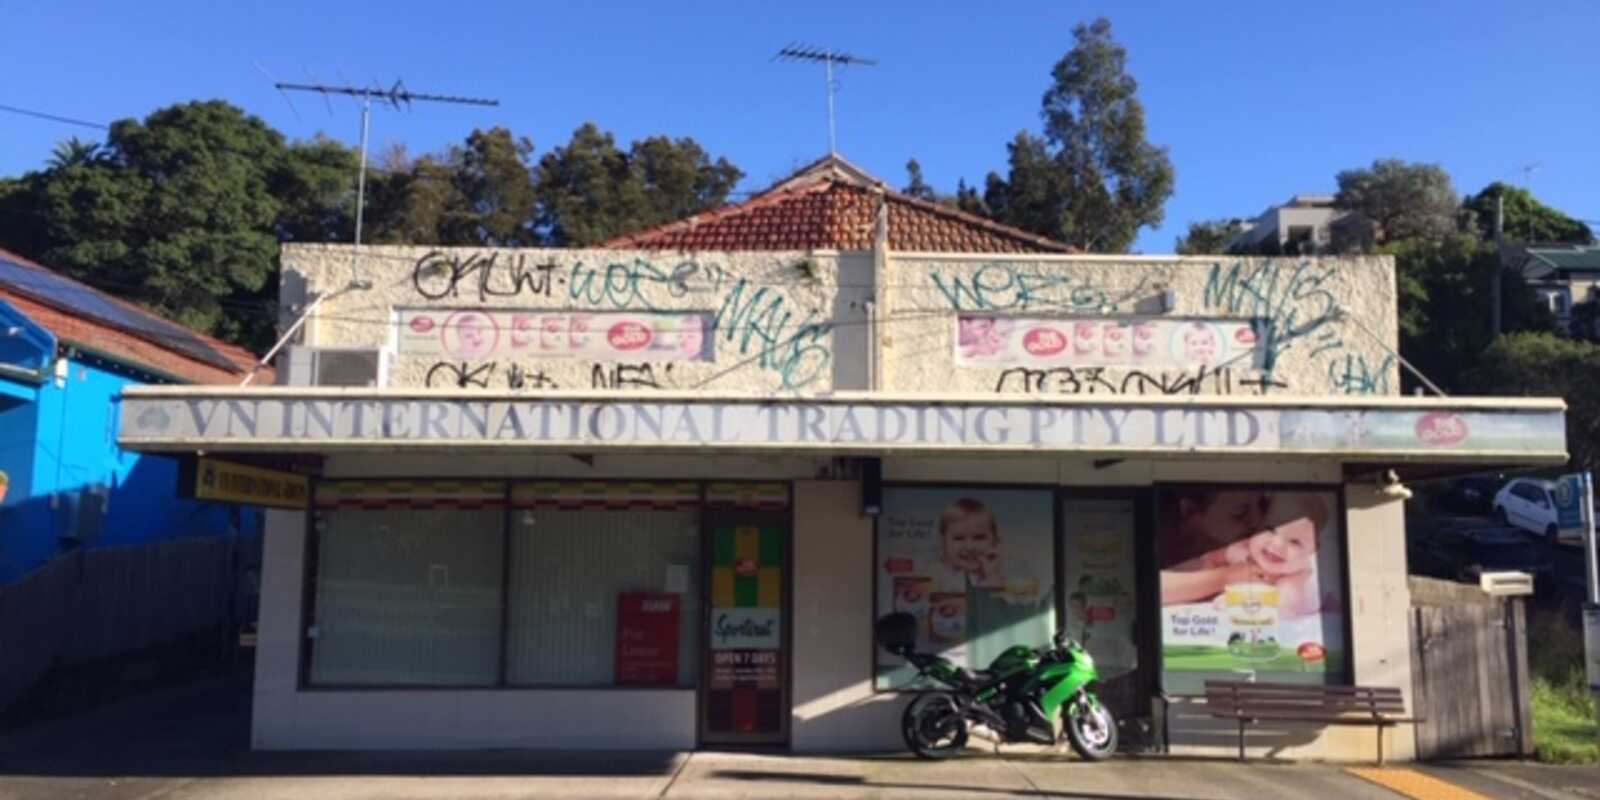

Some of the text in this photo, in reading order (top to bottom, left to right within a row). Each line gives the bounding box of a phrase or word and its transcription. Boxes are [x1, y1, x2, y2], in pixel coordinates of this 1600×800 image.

[185, 401, 1261, 448] VN INTERNATIONAL TRADING PTY LTD
[1192, 614, 1218, 626] Gold
